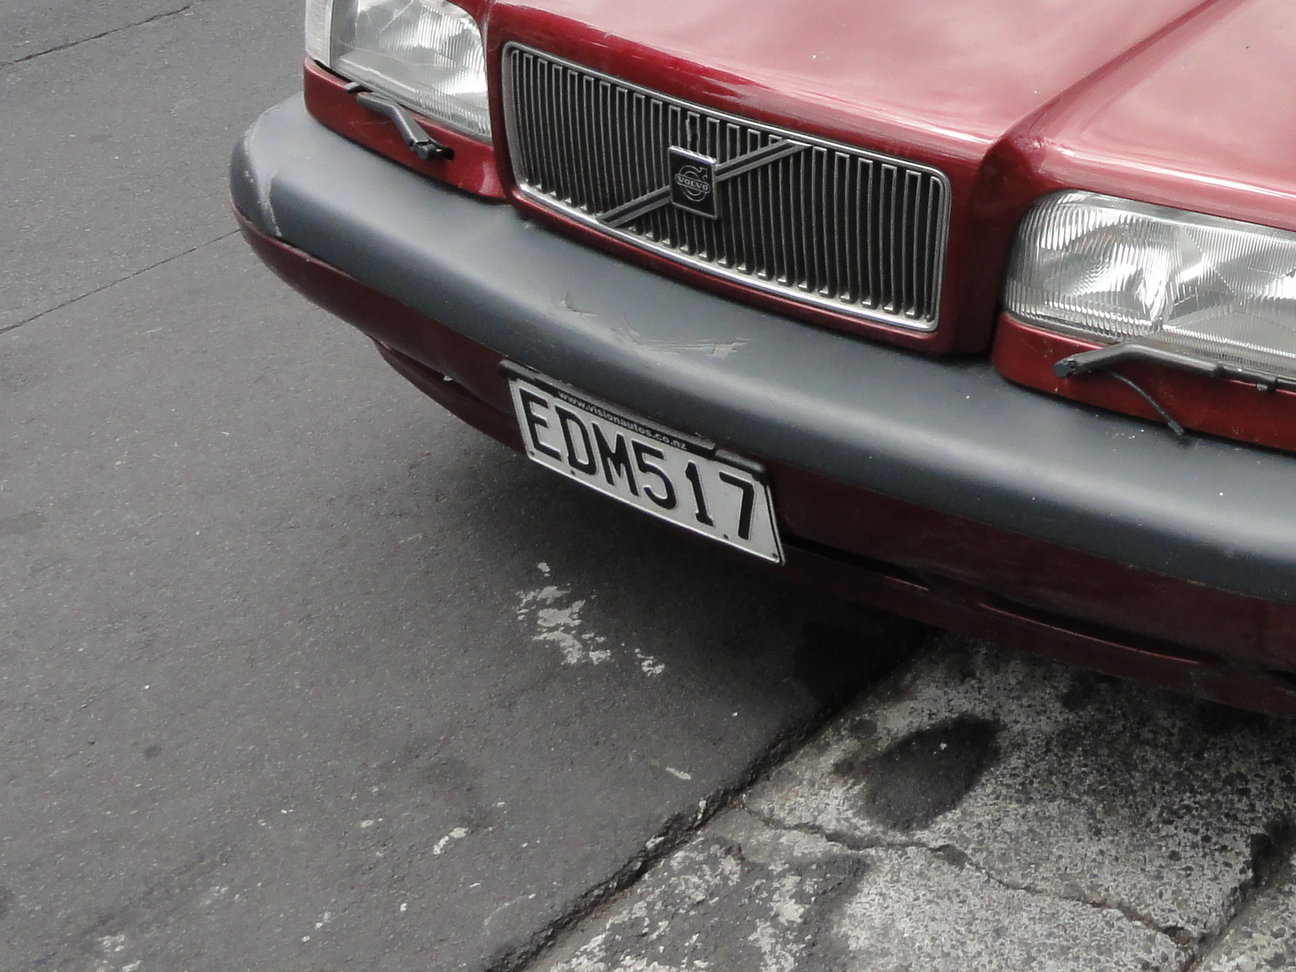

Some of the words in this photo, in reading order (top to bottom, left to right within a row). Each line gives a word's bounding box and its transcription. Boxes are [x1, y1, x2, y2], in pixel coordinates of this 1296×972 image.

[677, 176, 709, 191] VOLVO
[557, 390, 688, 450] www.visionautos.co.nz
[518, 387, 755, 541] EDM517
